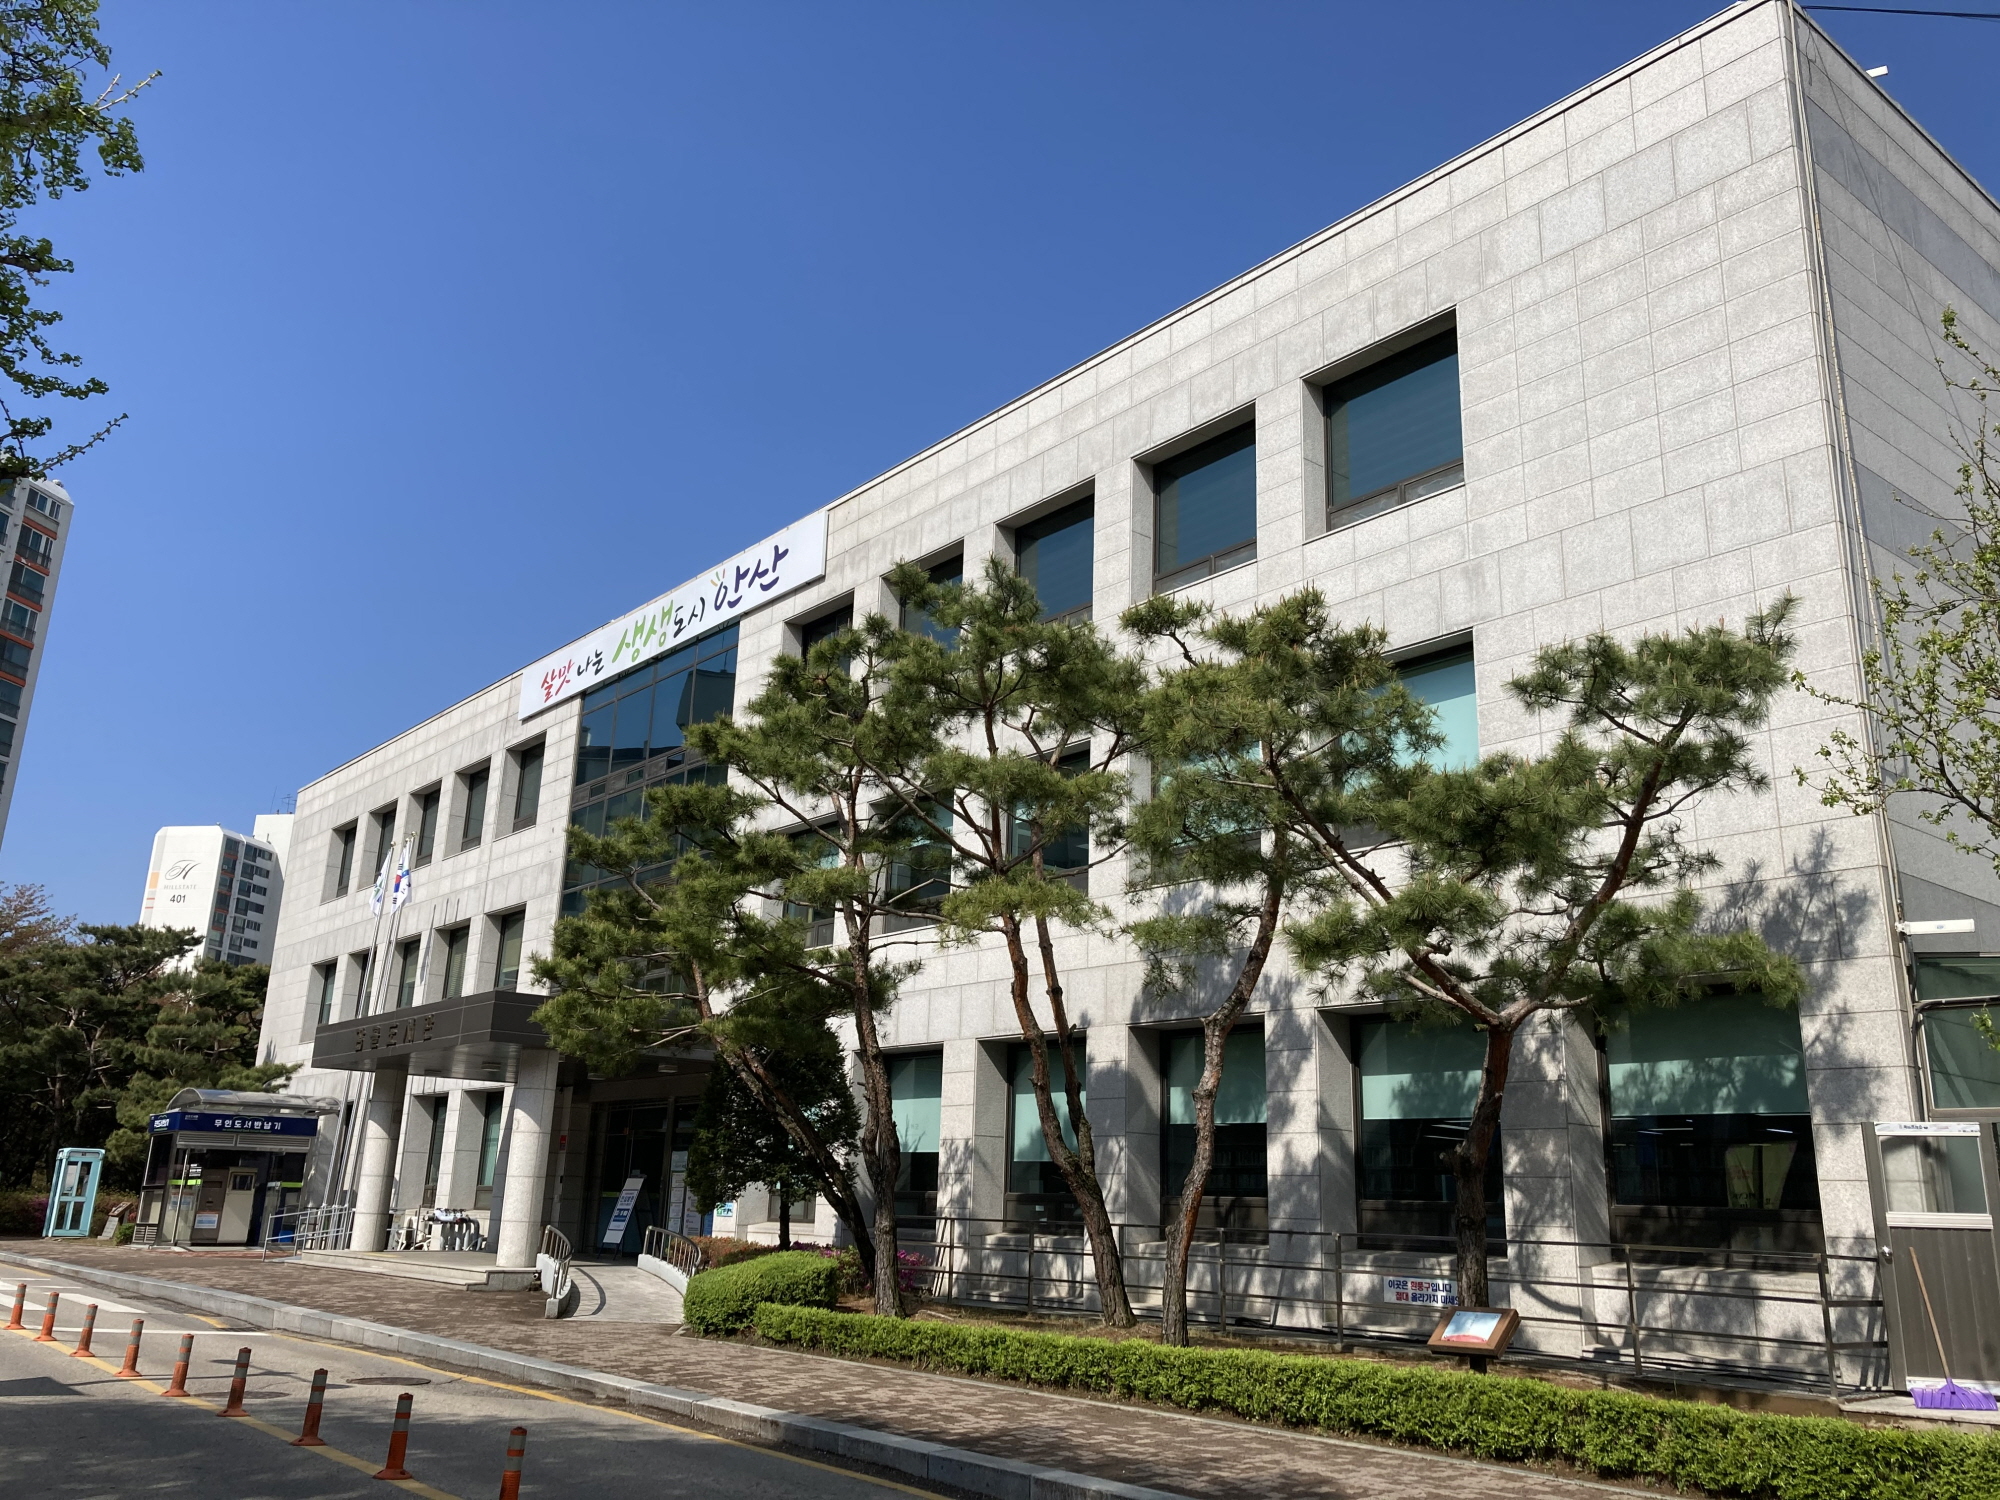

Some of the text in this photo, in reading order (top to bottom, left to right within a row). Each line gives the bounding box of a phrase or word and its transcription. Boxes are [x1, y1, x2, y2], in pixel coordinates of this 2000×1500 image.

[713, 545, 789, 611] 안산
[170, 894, 187, 904] 401
[214, 1119, 282, 1130] 무인도서반납기
[1388, 1279, 1408, 1290] 이곳은
[1395, 1291, 1409, 1301] 절대
[1411, 1292, 1438, 1304] 올라가지
